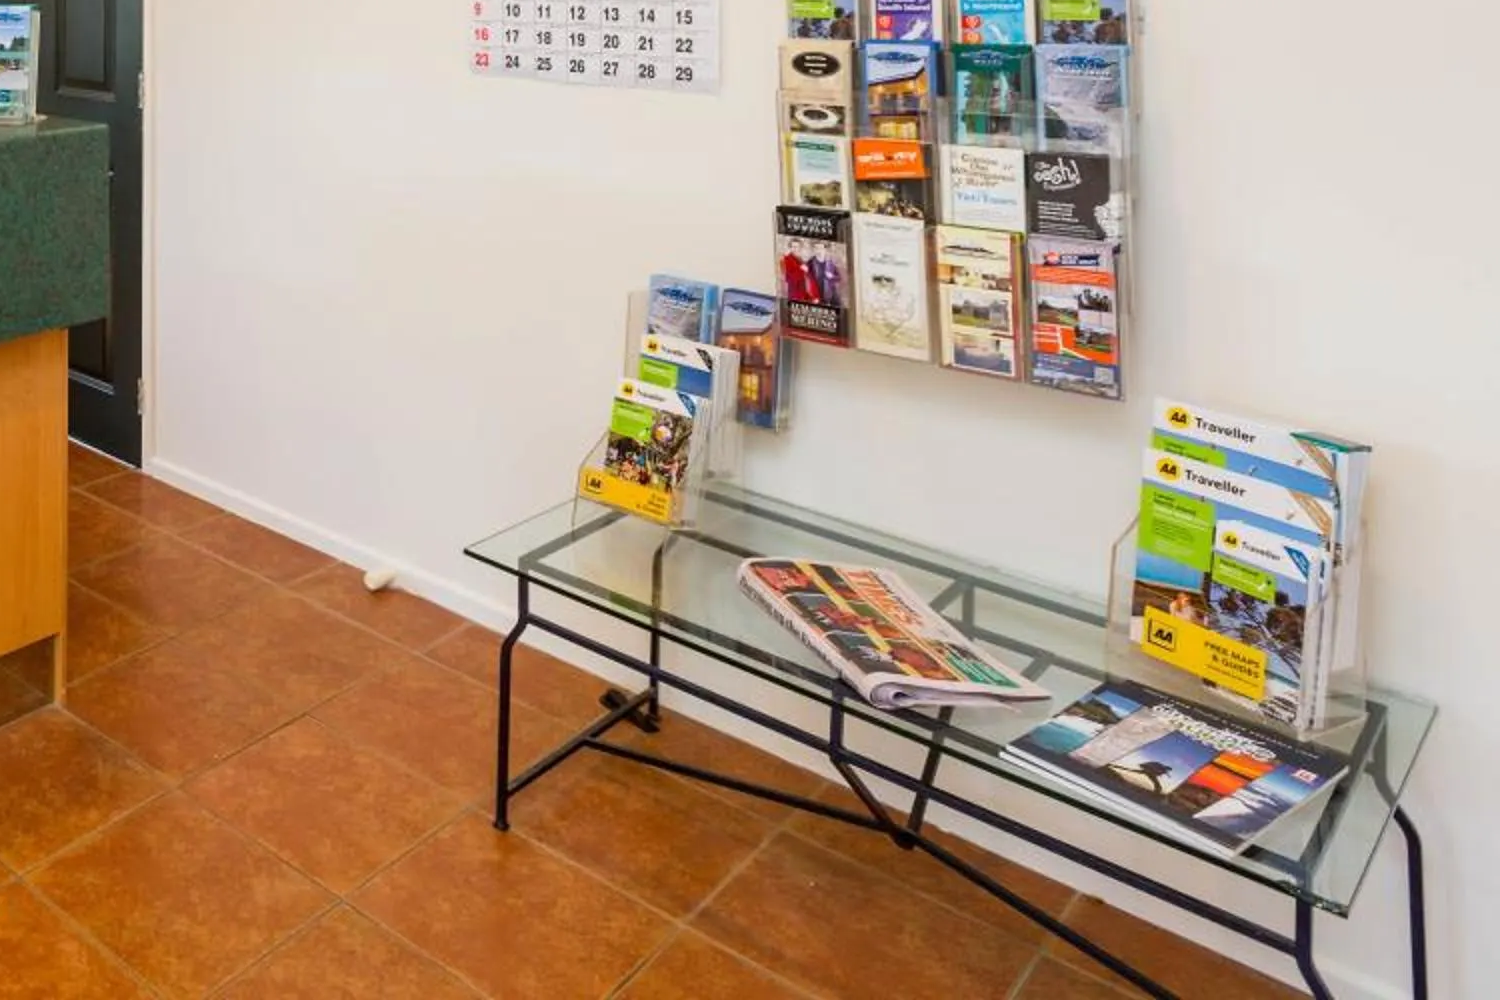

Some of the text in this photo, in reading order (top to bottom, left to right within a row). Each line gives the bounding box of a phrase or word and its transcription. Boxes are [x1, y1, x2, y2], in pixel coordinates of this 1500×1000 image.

[474, 3, 693, 24] 9 10 11 12 13 14 15
[475, 29, 693, 53] 16 17 18 19 20 21 22
[475, 53, 693, 82] 23 24 25 26 27 28 29
[1169, 411, 1257, 445] AA Traveller
[1160, 463, 1248, 498] AA Traveller
[1241, 541, 1281, 561] Traveller
[1153, 627, 1174, 644] AA
[1203, 640, 1260, 669] FREE MAPS
[1221, 658, 1260, 679] GUIDES
